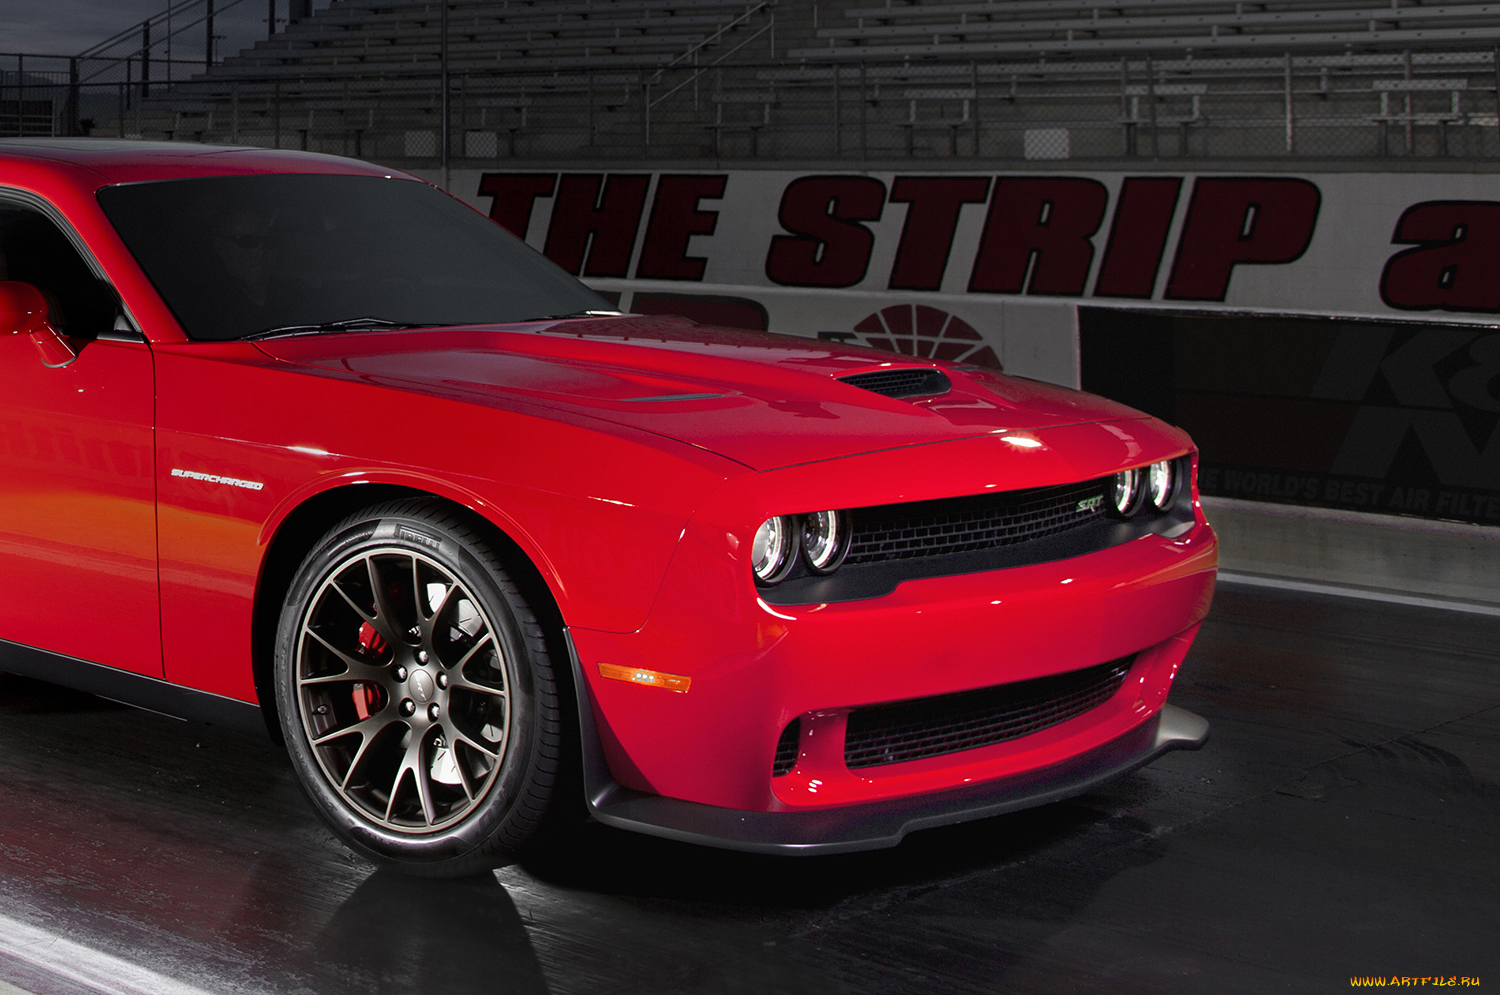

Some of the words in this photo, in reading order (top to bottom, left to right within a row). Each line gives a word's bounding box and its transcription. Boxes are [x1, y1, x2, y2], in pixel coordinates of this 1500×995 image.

[478, 173, 729, 281] THE
[765, 175, 1321, 302] STRIP
[170, 468, 264, 491] SUPERCHARGED
[1223, 470, 1319, 500] WORLD'S
[1325, 480, 1385, 507] BEST
[1388, 487, 1430, 512] AIR
[1075, 494, 1105, 513] SRT
